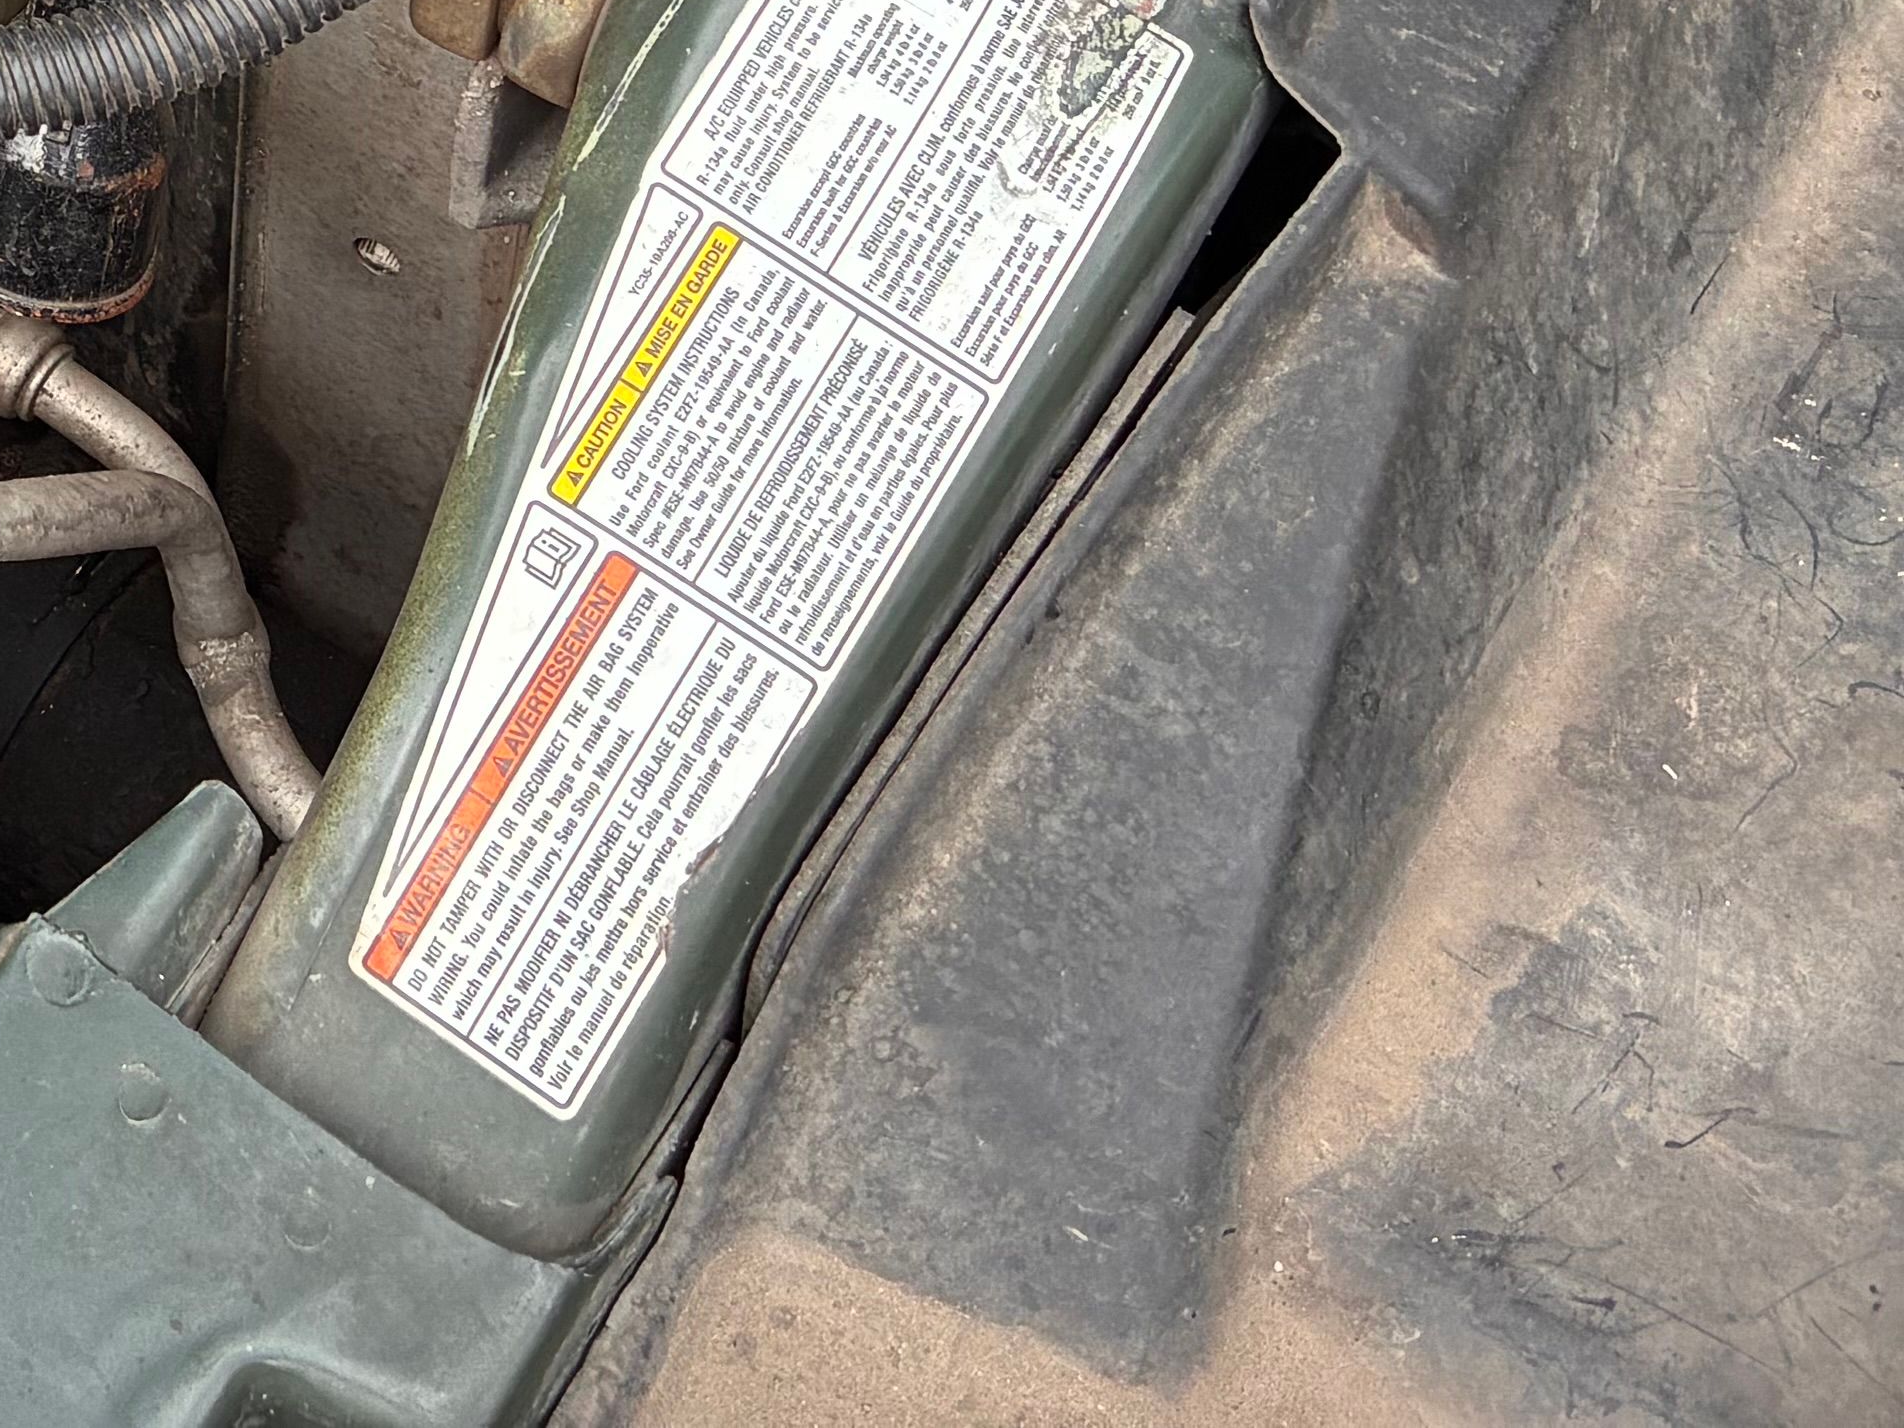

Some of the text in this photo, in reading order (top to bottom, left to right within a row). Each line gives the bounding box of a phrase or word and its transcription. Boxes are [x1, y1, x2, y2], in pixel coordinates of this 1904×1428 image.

[703, 115, 726, 142] A/C
[716, 59, 761, 117] EQUIPPED
[752, 5, 795, 60] VEHICLES
[644, 316, 679, 359] MISE
[670, 293, 693, 319] EN
[686, 238, 728, 294] GARDE
[576, 398, 627, 469] CAUTION
[611, 286, 740, 480] COOLING SYSTEM INSTRUCTIONS
[503, 578, 618, 761] AVERTISSEMENT
[407, 587, 659, 992] DO NOT TAMPER WITH OR DISCONNECT THE AIR BAG SYSTEM
[396, 819, 472, 935] WARNING
